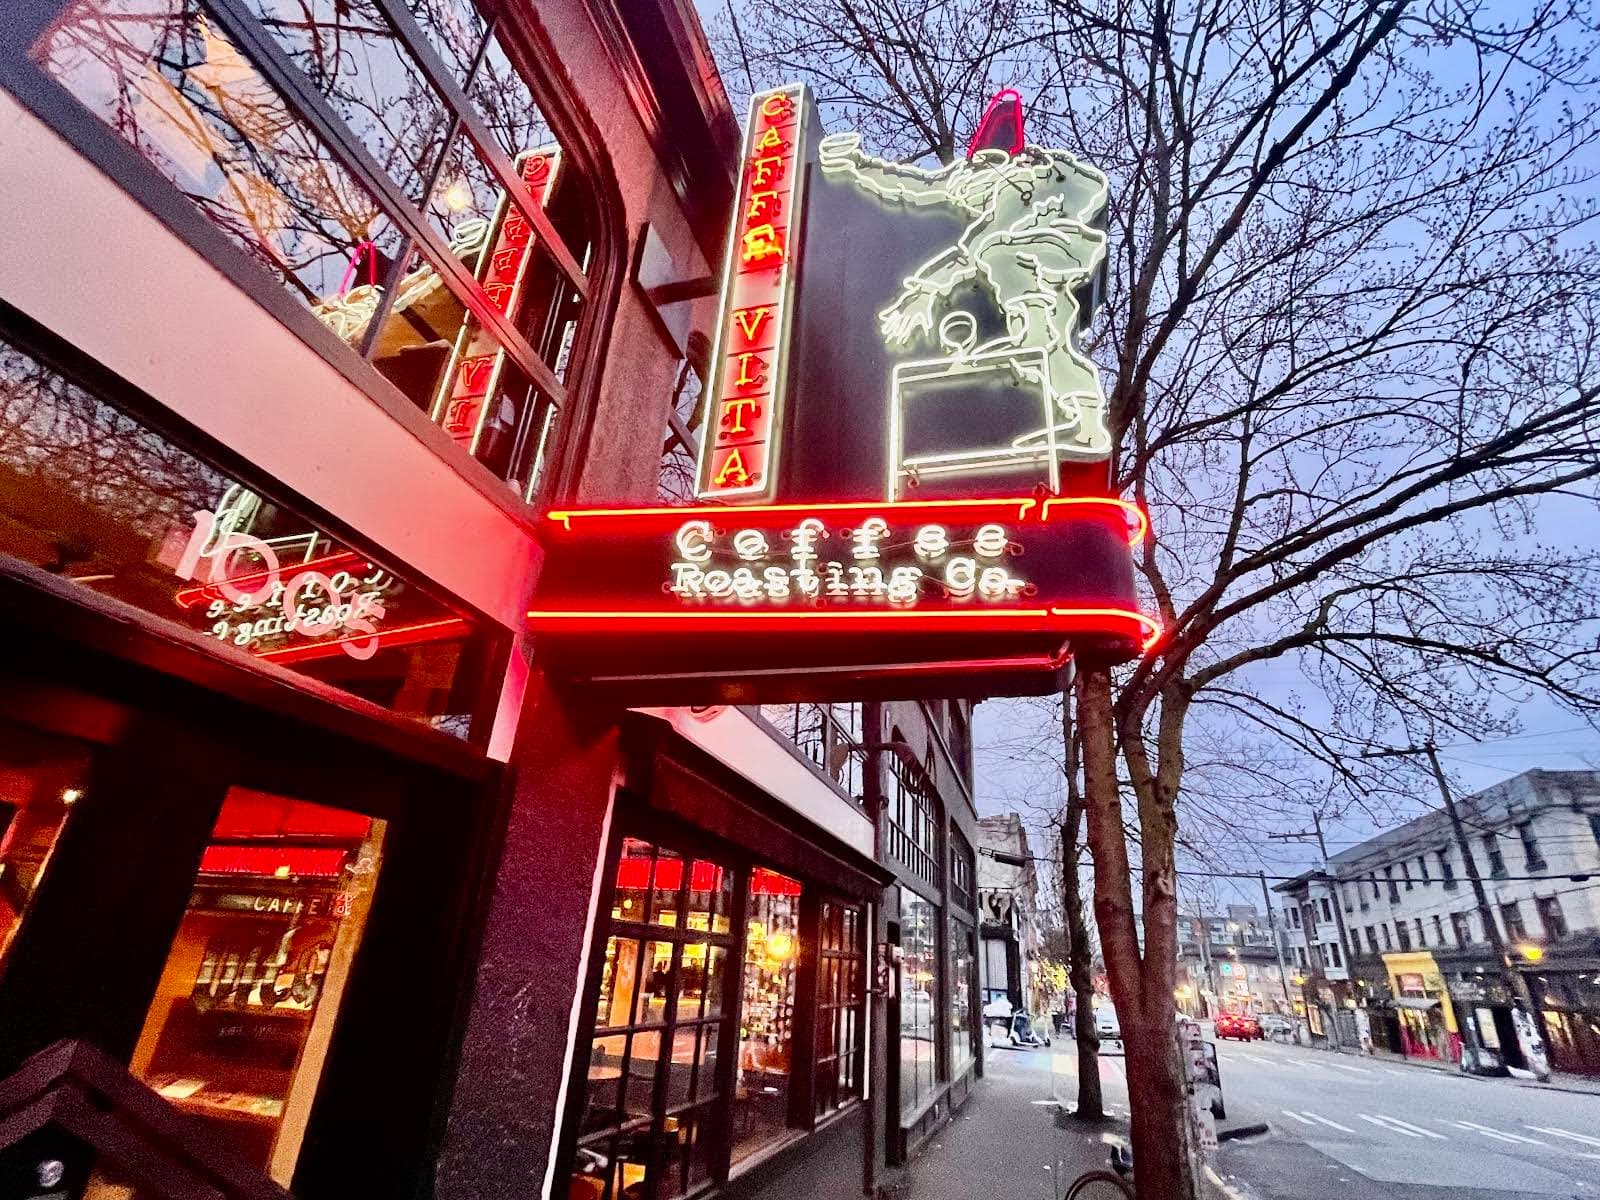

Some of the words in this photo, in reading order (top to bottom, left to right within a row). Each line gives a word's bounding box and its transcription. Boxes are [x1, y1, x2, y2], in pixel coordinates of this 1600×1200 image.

[742, 93, 787, 263] CAFFE
[714, 307, 771, 485] VITA
[175, 509, 386, 661] 1005
[671, 557, 922, 603] Roasting
[675, 517, 1008, 562] Coffee
